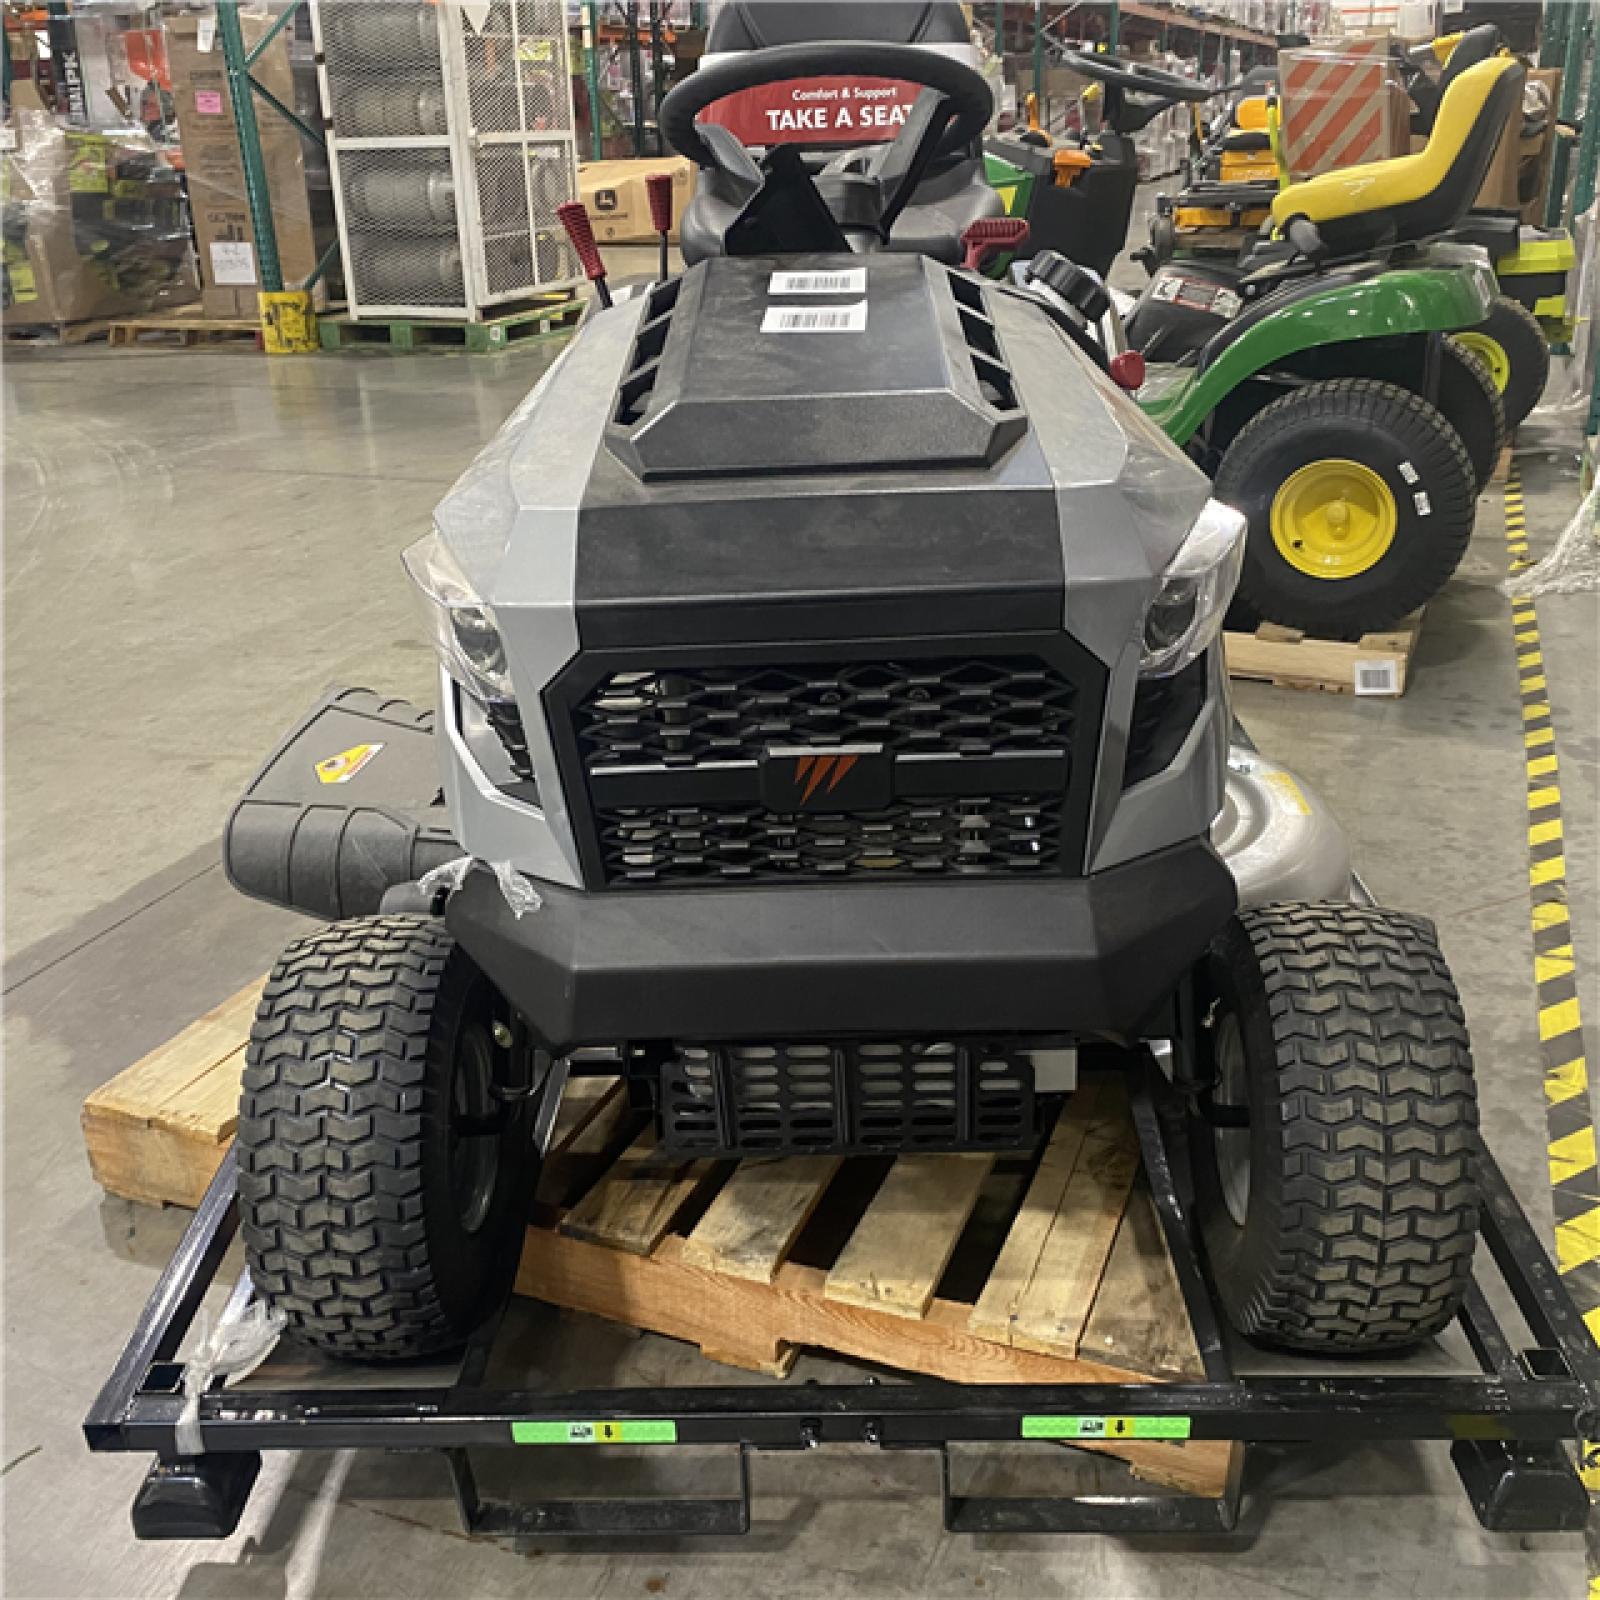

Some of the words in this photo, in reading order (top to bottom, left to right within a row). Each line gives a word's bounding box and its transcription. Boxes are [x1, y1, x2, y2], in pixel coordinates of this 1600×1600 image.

[792, 87, 839, 101] Comfort
[842, 86, 850, 98] &
[854, 85, 898, 100] Support
[765, 108, 828, 131] TAKE
[835, 105, 853, 128] A
